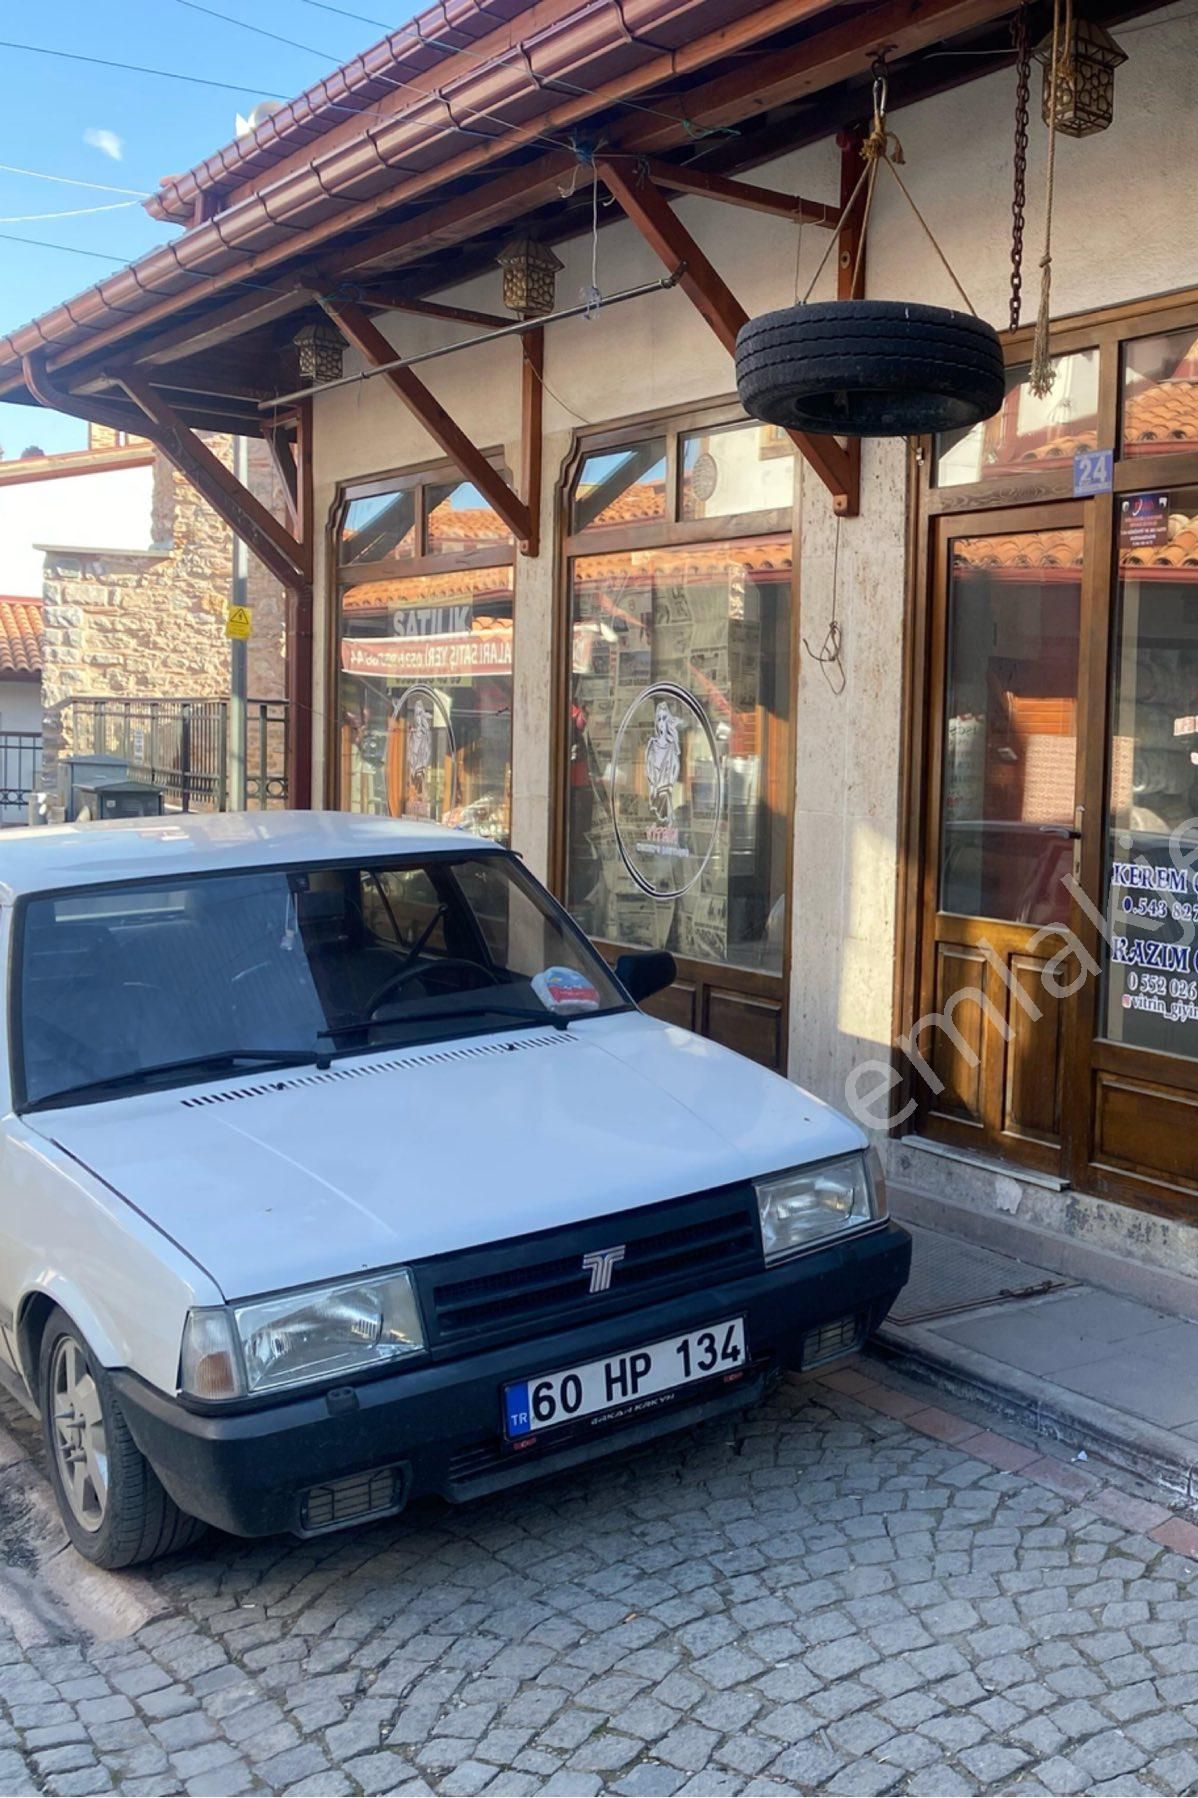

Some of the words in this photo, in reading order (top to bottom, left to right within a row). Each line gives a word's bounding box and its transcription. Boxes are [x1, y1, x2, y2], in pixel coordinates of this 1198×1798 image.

[1079, 455, 1107, 487] 24
[1112, 862, 1187, 893] KEREM
[1122, 896, 1168, 917] 0.543
[1112, 937, 1190, 972] KAZIM
[1140, 974, 1167, 994] 552
[1169, 978, 1197, 1000] 026
[532, 1373, 584, 1422] 60
[604, 1353, 652, 1403] HP
[676, 1324, 742, 1378] 134
[510, 1411, 528, 1428] TR
